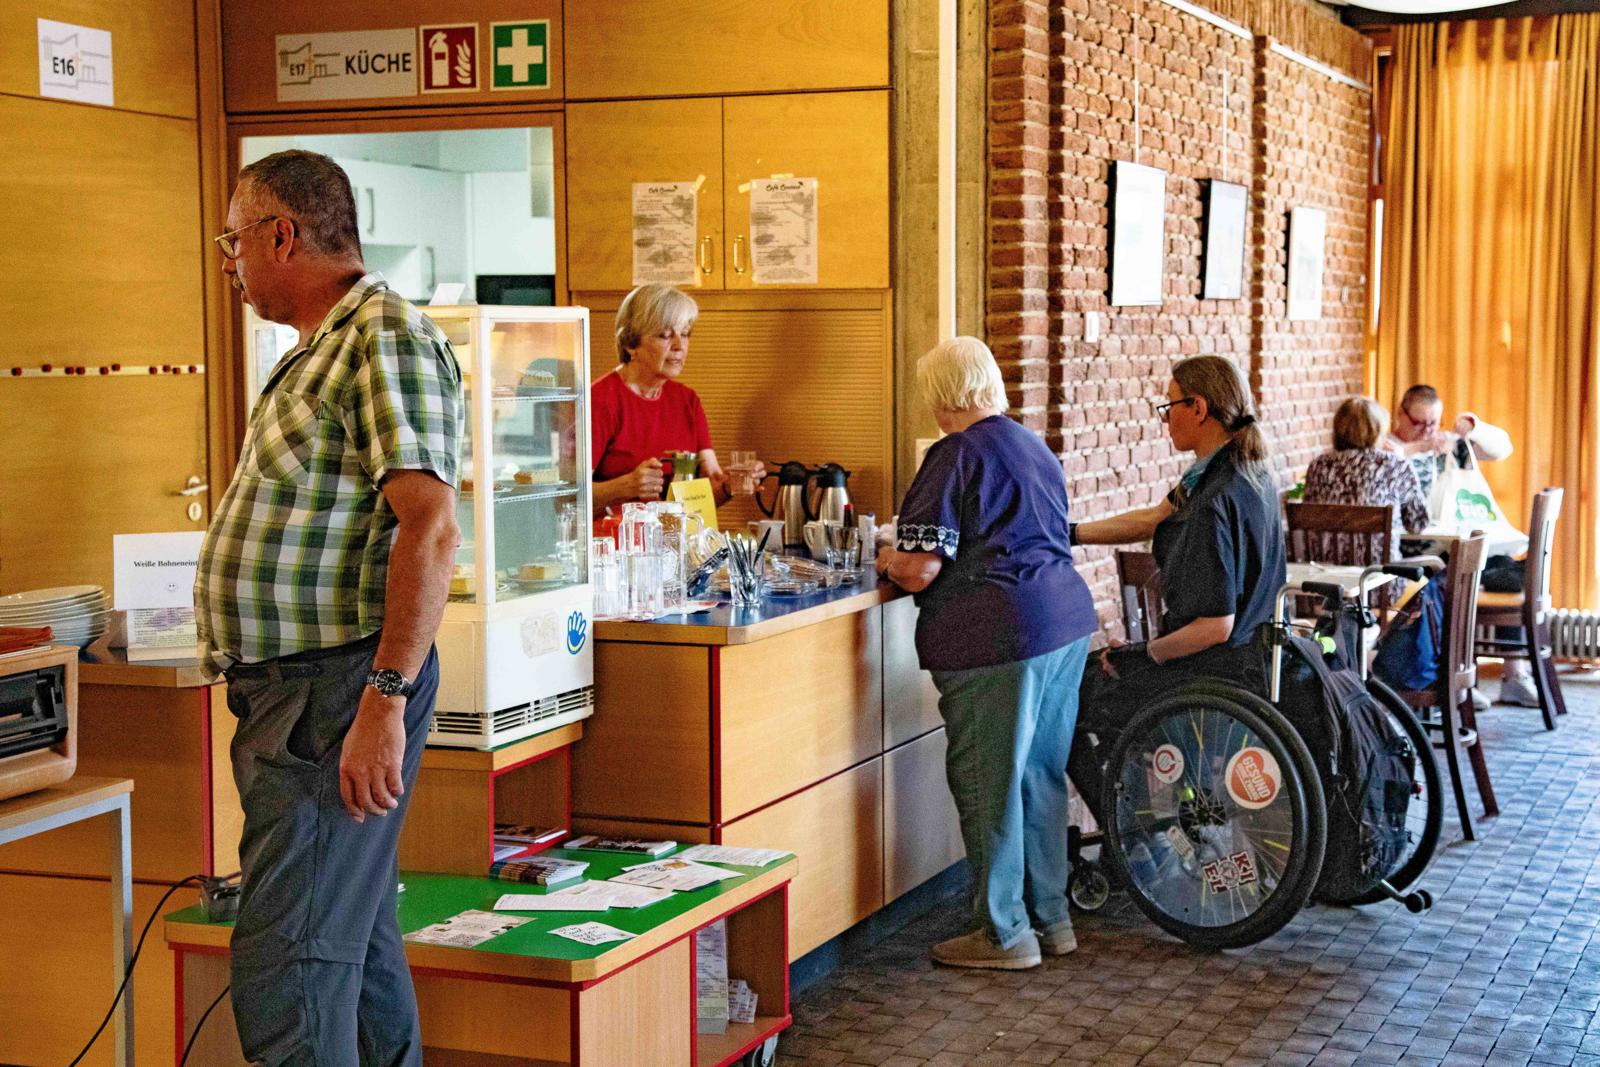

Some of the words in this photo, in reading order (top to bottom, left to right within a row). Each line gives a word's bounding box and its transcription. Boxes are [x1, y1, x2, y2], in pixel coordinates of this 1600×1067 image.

[52, 56, 75, 76] E16
[289, 63, 305, 76] E17
[345, 50, 412, 75] KÜCHE
[1242, 756, 1271, 798] GESUND
